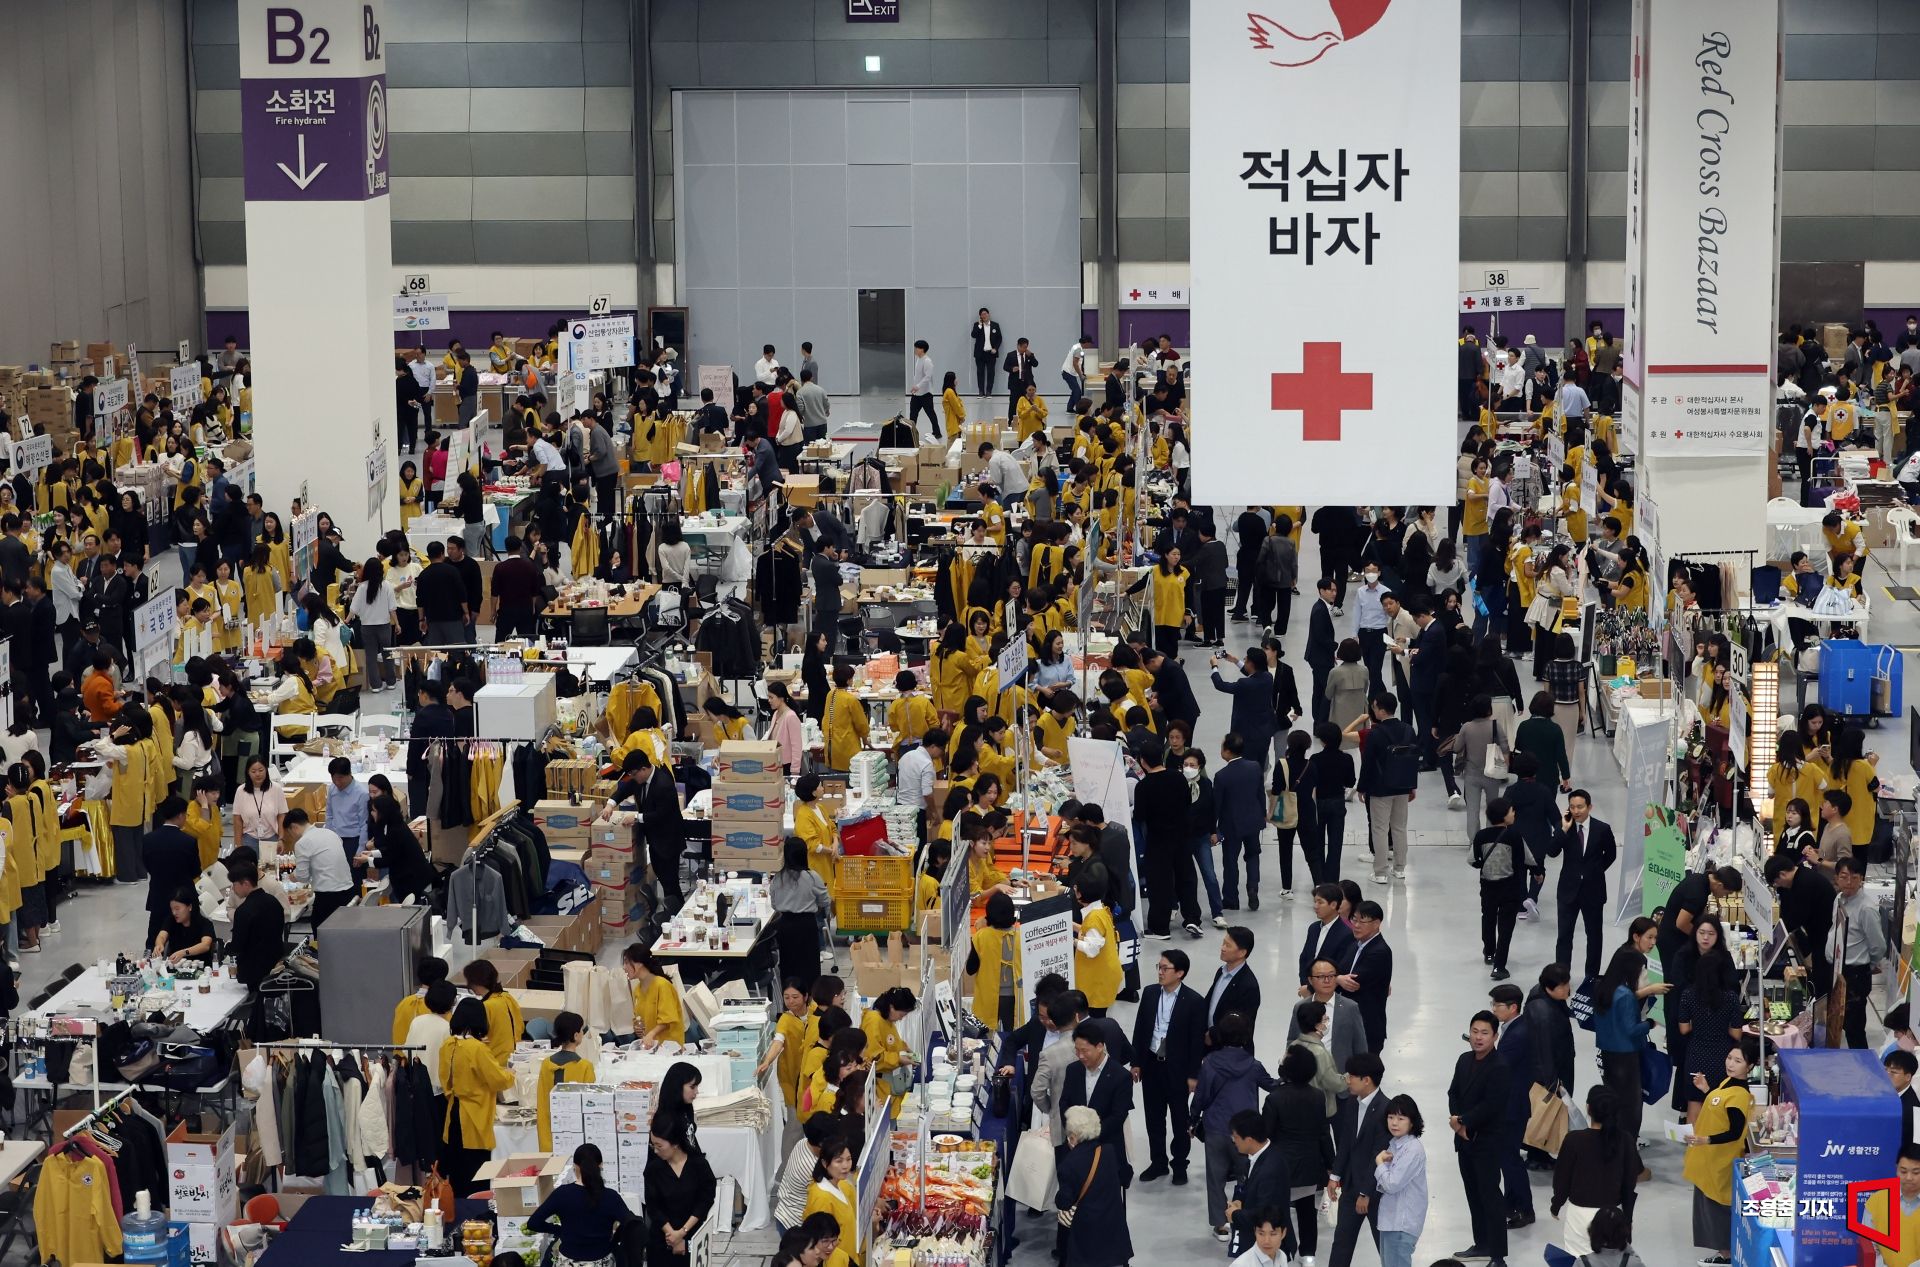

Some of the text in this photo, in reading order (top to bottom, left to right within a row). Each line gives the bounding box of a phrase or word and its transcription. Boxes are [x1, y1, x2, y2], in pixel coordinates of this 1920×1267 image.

[874, 6, 896, 15] EXIT
[267, 8, 330, 64] B2
[364, 5, 381, 61] B2
[265, 89, 336, 115] 소화전
[275, 116, 326, 127] Fire hydrant
[1239, 148, 1409, 202] 적십자
[1694, 31, 1734, 335] Red Cross Bazaar
[1269, 212, 1380, 266] 바자
[409, 278, 426, 290] 68
[1488, 273, 1505, 285] 38
[593, 297, 607, 311] 67
[588, 326, 630, 338] 산업통상자원부
[105, 360, 113, 376] 71
[575, 372, 586, 380] GS
[1687, 396, 1727, 404] 대한적십자사
[1730, 396, 1743, 404] 본사
[1686, 407, 1761, 415] 여성봉사특별자문위원회
[22, 418, 31, 435] 72
[1686, 431, 1727, 439] 대한적십자사
[1729, 431, 1763, 439] 수요봉사회
[150, 570, 159, 593] 62
[1732, 650, 1744, 678] 30
[1648, 862, 1681, 883] 순대스테이크
[557, 884, 595, 916] SE
[1024, 918, 1067, 939] coffeesmith
[1033, 943, 1044, 951] 2024
[1045, 938, 1058, 948] 적십자
[1041, 953, 1068, 968] 커피스미스가
[1847, 1146, 1880, 1155] 생활건강
[190, 1247, 210, 1262] 반시
